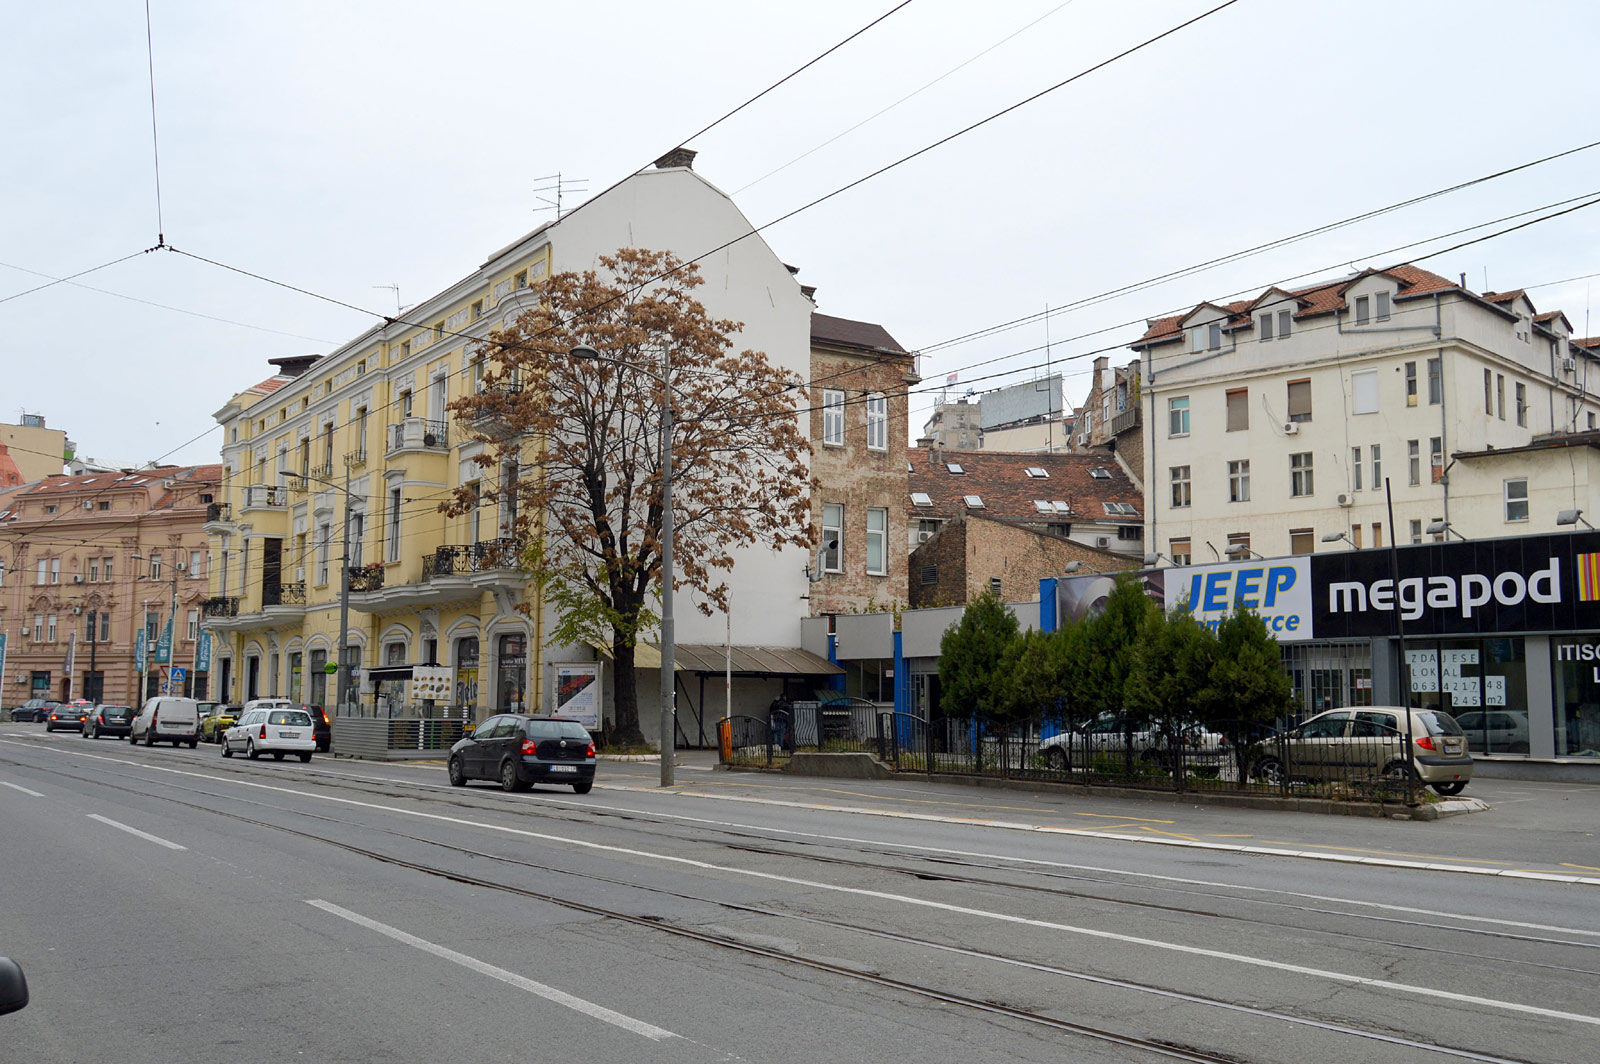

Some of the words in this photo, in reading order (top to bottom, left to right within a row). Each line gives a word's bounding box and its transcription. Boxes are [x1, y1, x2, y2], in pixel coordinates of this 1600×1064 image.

[1177, 565, 1298, 613] JEEP
[1329, 557, 1561, 621] megapod
[1412, 668, 1457, 677] LOKAL
